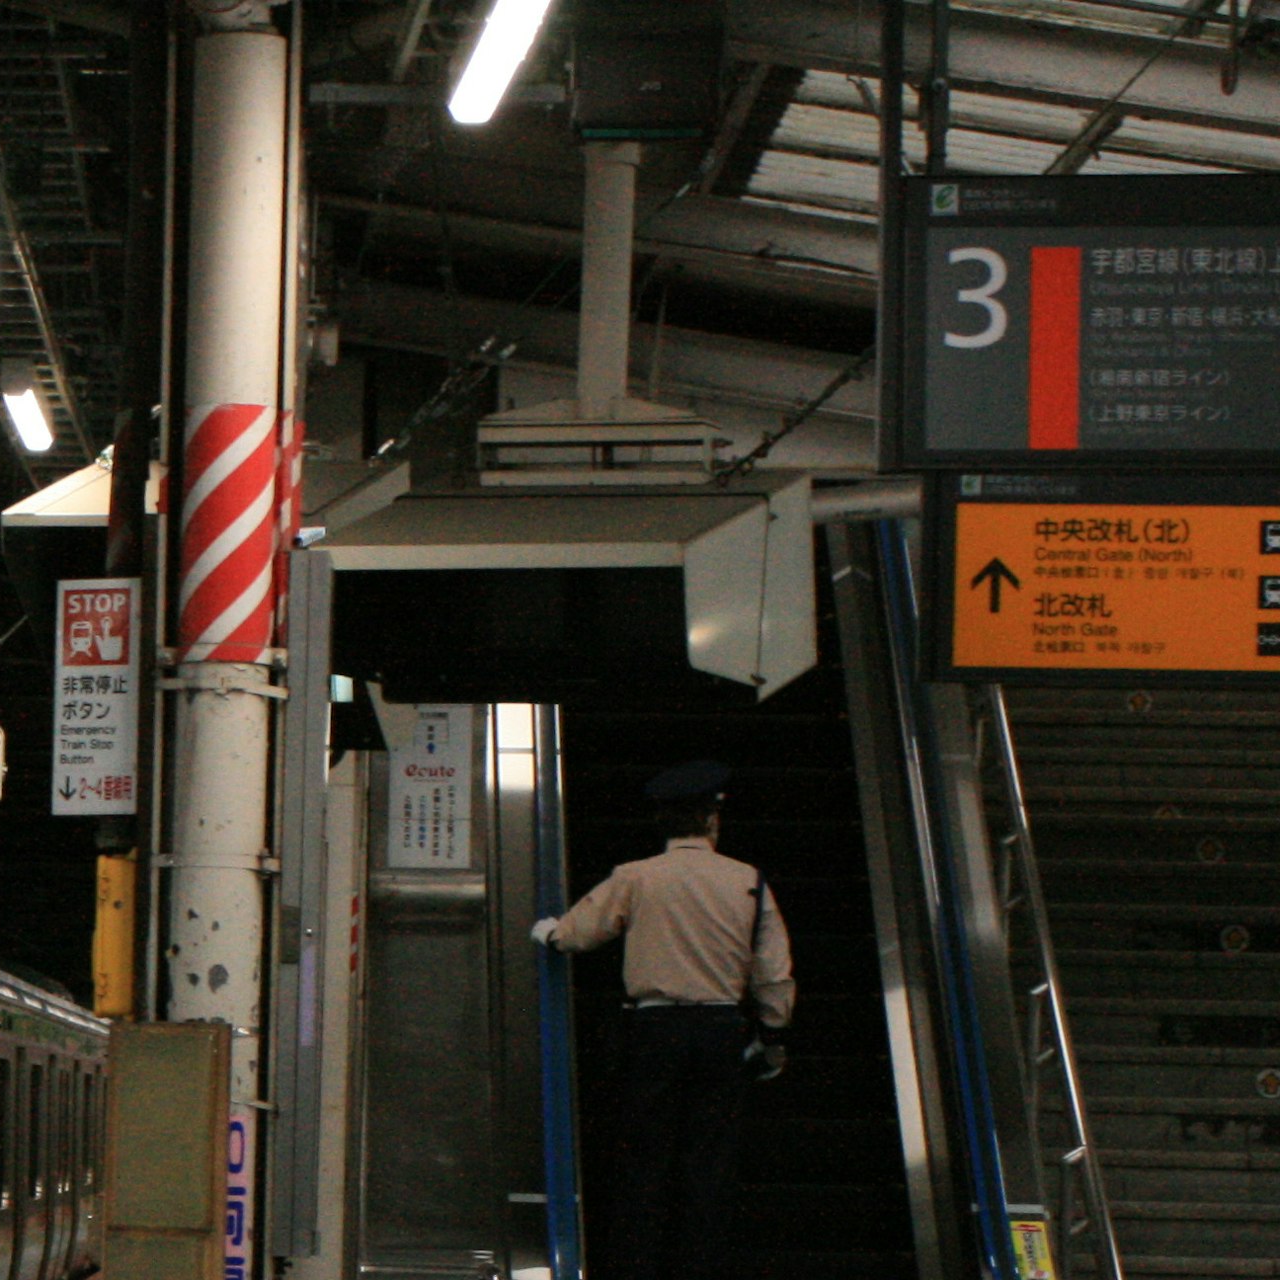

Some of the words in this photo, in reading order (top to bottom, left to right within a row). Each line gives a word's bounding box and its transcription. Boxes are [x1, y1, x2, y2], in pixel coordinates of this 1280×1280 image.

[943, 246, 1009, 350] 3
[1034, 517, 1191, 544] 中央改札(北)
[1034, 548, 1092, 562] Central
[1095, 548, 1134, 562] Gate
[1139, 548, 1193, 563] (North)
[68, 593, 127, 615] STOP
[1033, 592, 1113, 618] 北改札
[1032, 622, 1075, 636] North
[1080, 622, 1118, 637] Gate
[62, 675, 129, 695] 非常停止
[61, 702, 111, 720] ボタン
[60, 725, 117, 737] Emergency
[60, 739, 87, 750] Train
[89, 739, 115, 752] Stop
[60, 753, 95, 765] Button
